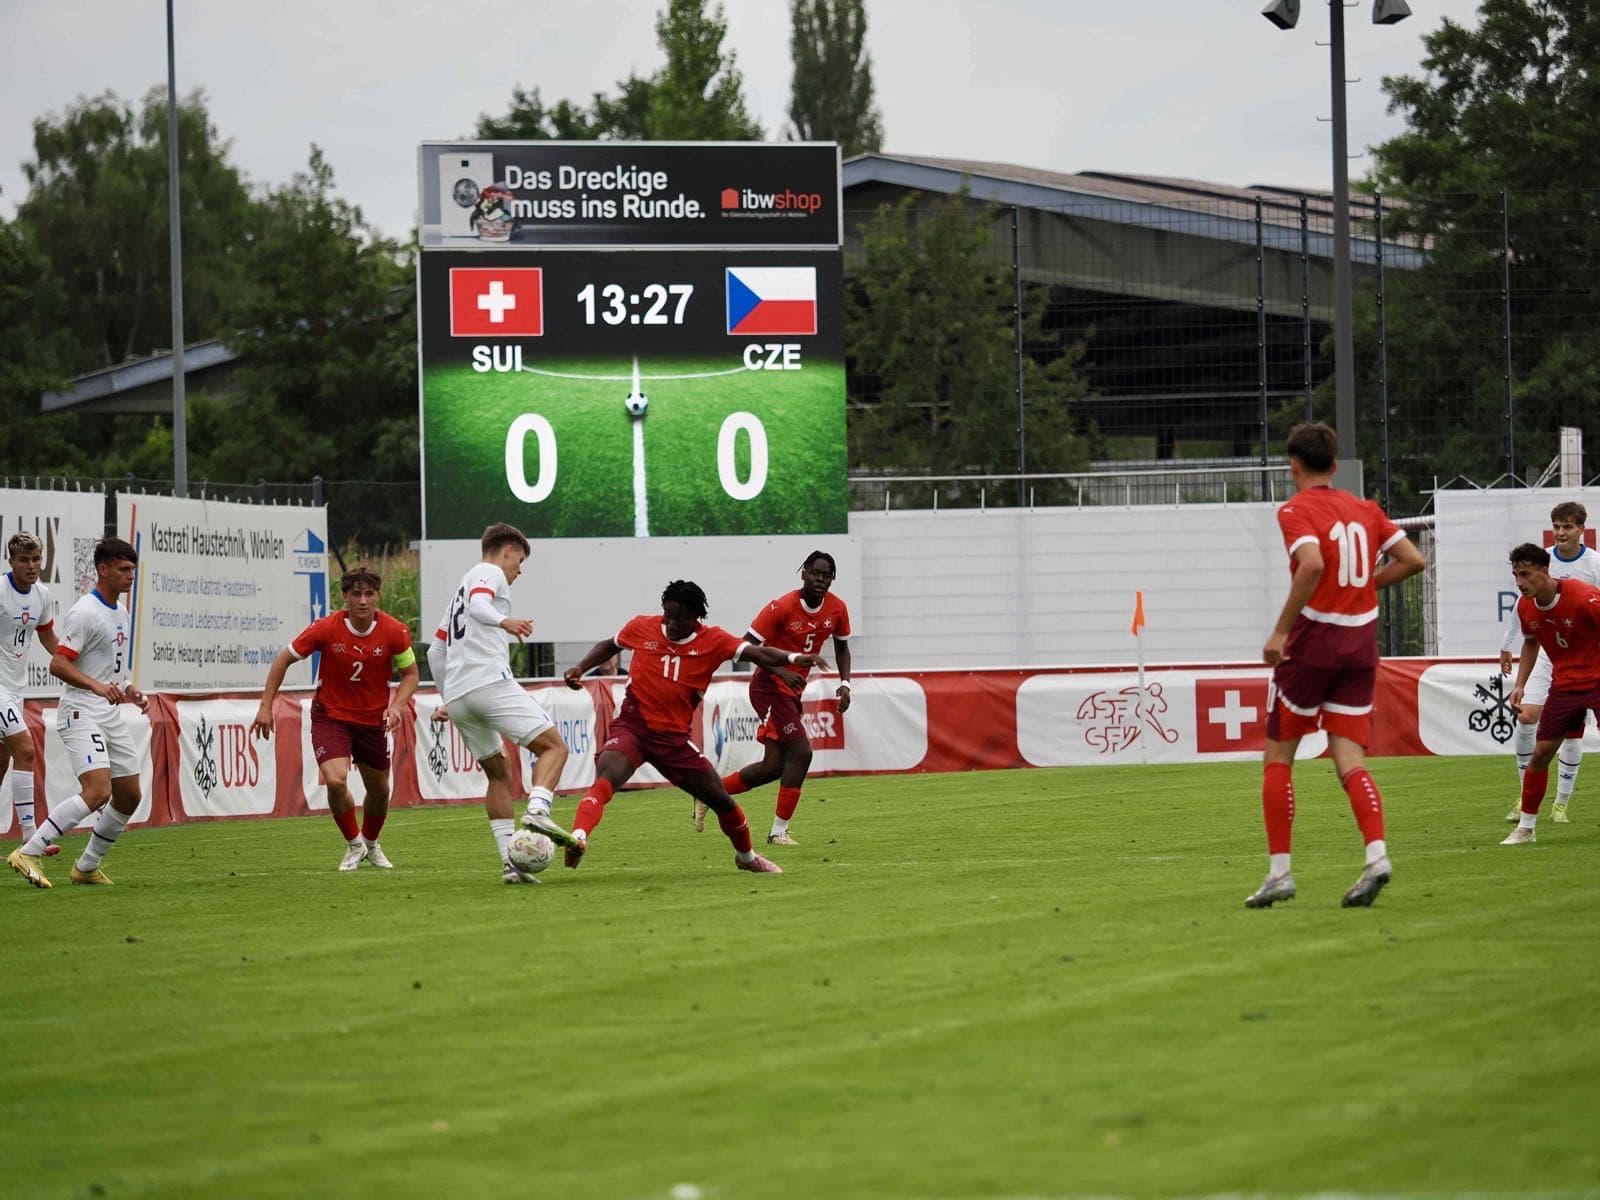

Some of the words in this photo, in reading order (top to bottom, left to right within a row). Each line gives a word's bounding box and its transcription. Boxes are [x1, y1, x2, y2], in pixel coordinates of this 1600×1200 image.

[504, 165, 552, 190] Das
[558, 165, 668, 196] Dreckige
[510, 199, 576, 219] muss
[581, 193, 617, 219] ins
[622, 193, 706, 219] Runde.
[742, 188, 822, 214] ibwshop
[576, 283, 694, 326] 13:27
[472, 345, 522, 372] SUI
[743, 344, 802, 370] CZE
[505, 413, 558, 503] 0
[717, 411, 769, 500] 0
[151, 522, 189, 554] Kastrati
[192, 525, 249, 564] Haustechnik,
[250, 529, 285, 559] Wohlen
[1328, 520, 1370, 589] 10
[152, 572, 160, 592] FC
[161, 573, 186, 594] Wohlen
[187, 577, 198, 595] und
[181, 609, 193, 628] und
[447, 586, 467, 647] 12
[13, 626, 26, 648] 14
[803, 633, 815, 652] 5
[1556, 631, 1569, 649] 6
[114, 652, 122, 674] 5
[153, 641, 176, 664] Sanitär,
[178, 642, 202, 668] Heizung
[204, 644, 216, 663] und
[349, 661, 364, 682] 2
[660, 654, 681, 682] 11
[91, 734, 105, 753] 5
[218, 723, 260, 788] UBS
